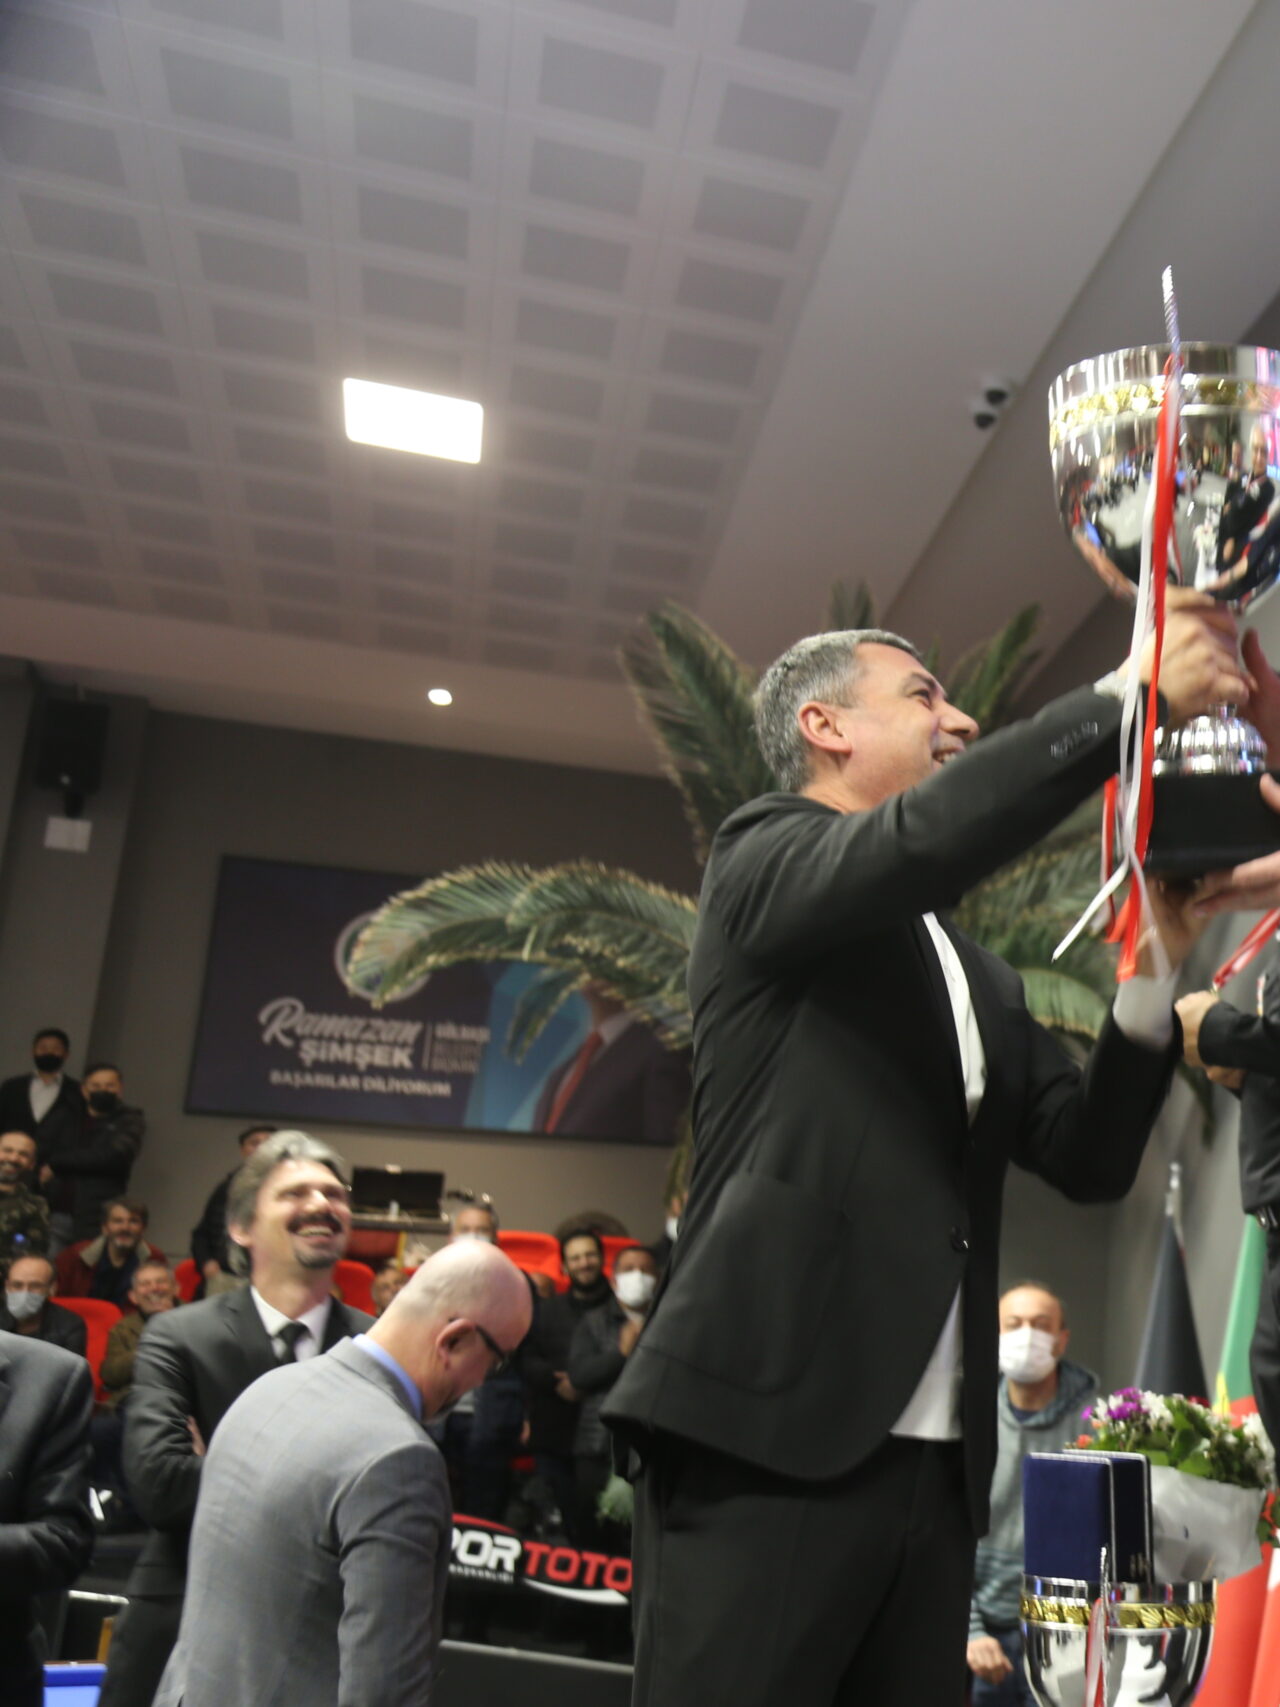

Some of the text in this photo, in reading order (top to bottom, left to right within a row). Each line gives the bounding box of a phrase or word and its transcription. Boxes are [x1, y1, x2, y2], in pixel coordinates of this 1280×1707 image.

[258, 996, 423, 1048] Ramazan
[299, 1038, 415, 1072] ŞİMŞEK
[523, 1540, 633, 1593] TOTO
